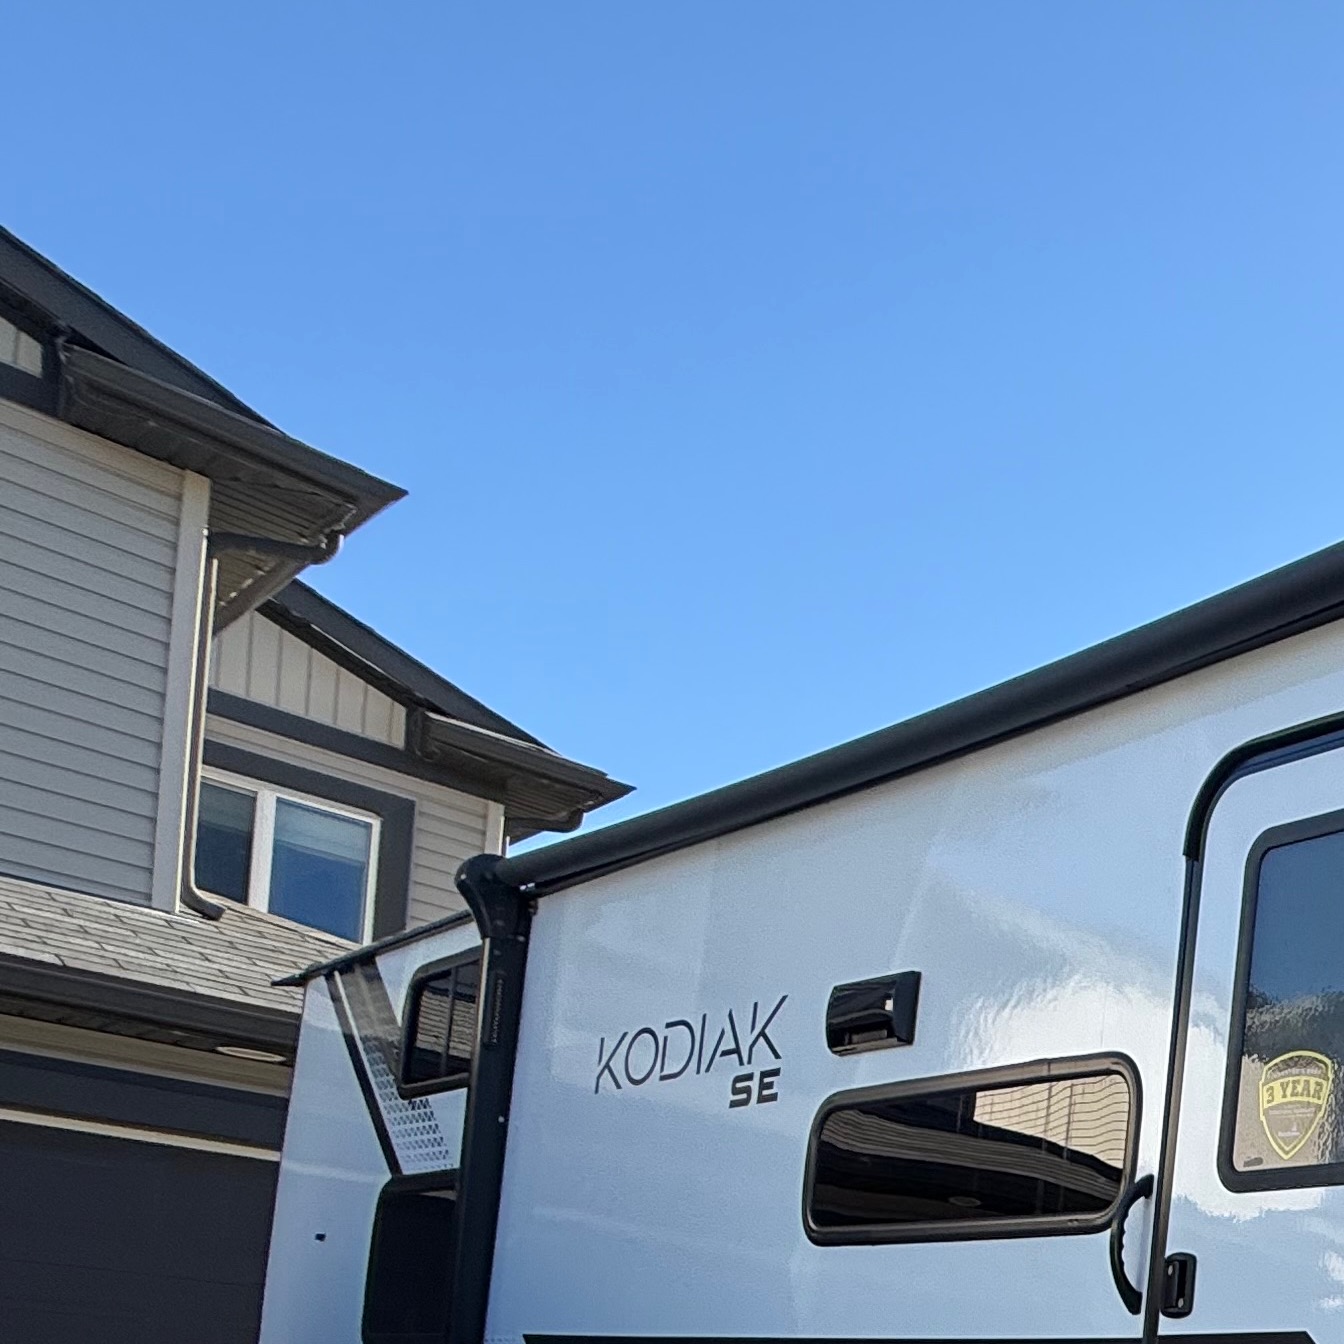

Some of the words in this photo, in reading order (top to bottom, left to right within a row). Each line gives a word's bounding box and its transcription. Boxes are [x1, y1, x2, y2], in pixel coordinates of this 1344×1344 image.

[594, 994, 789, 1095] KODIAK
[728, 1067, 782, 1109] SE
[1265, 1085, 1275, 1104] 3
[1280, 1079, 1325, 1101] YEAR
